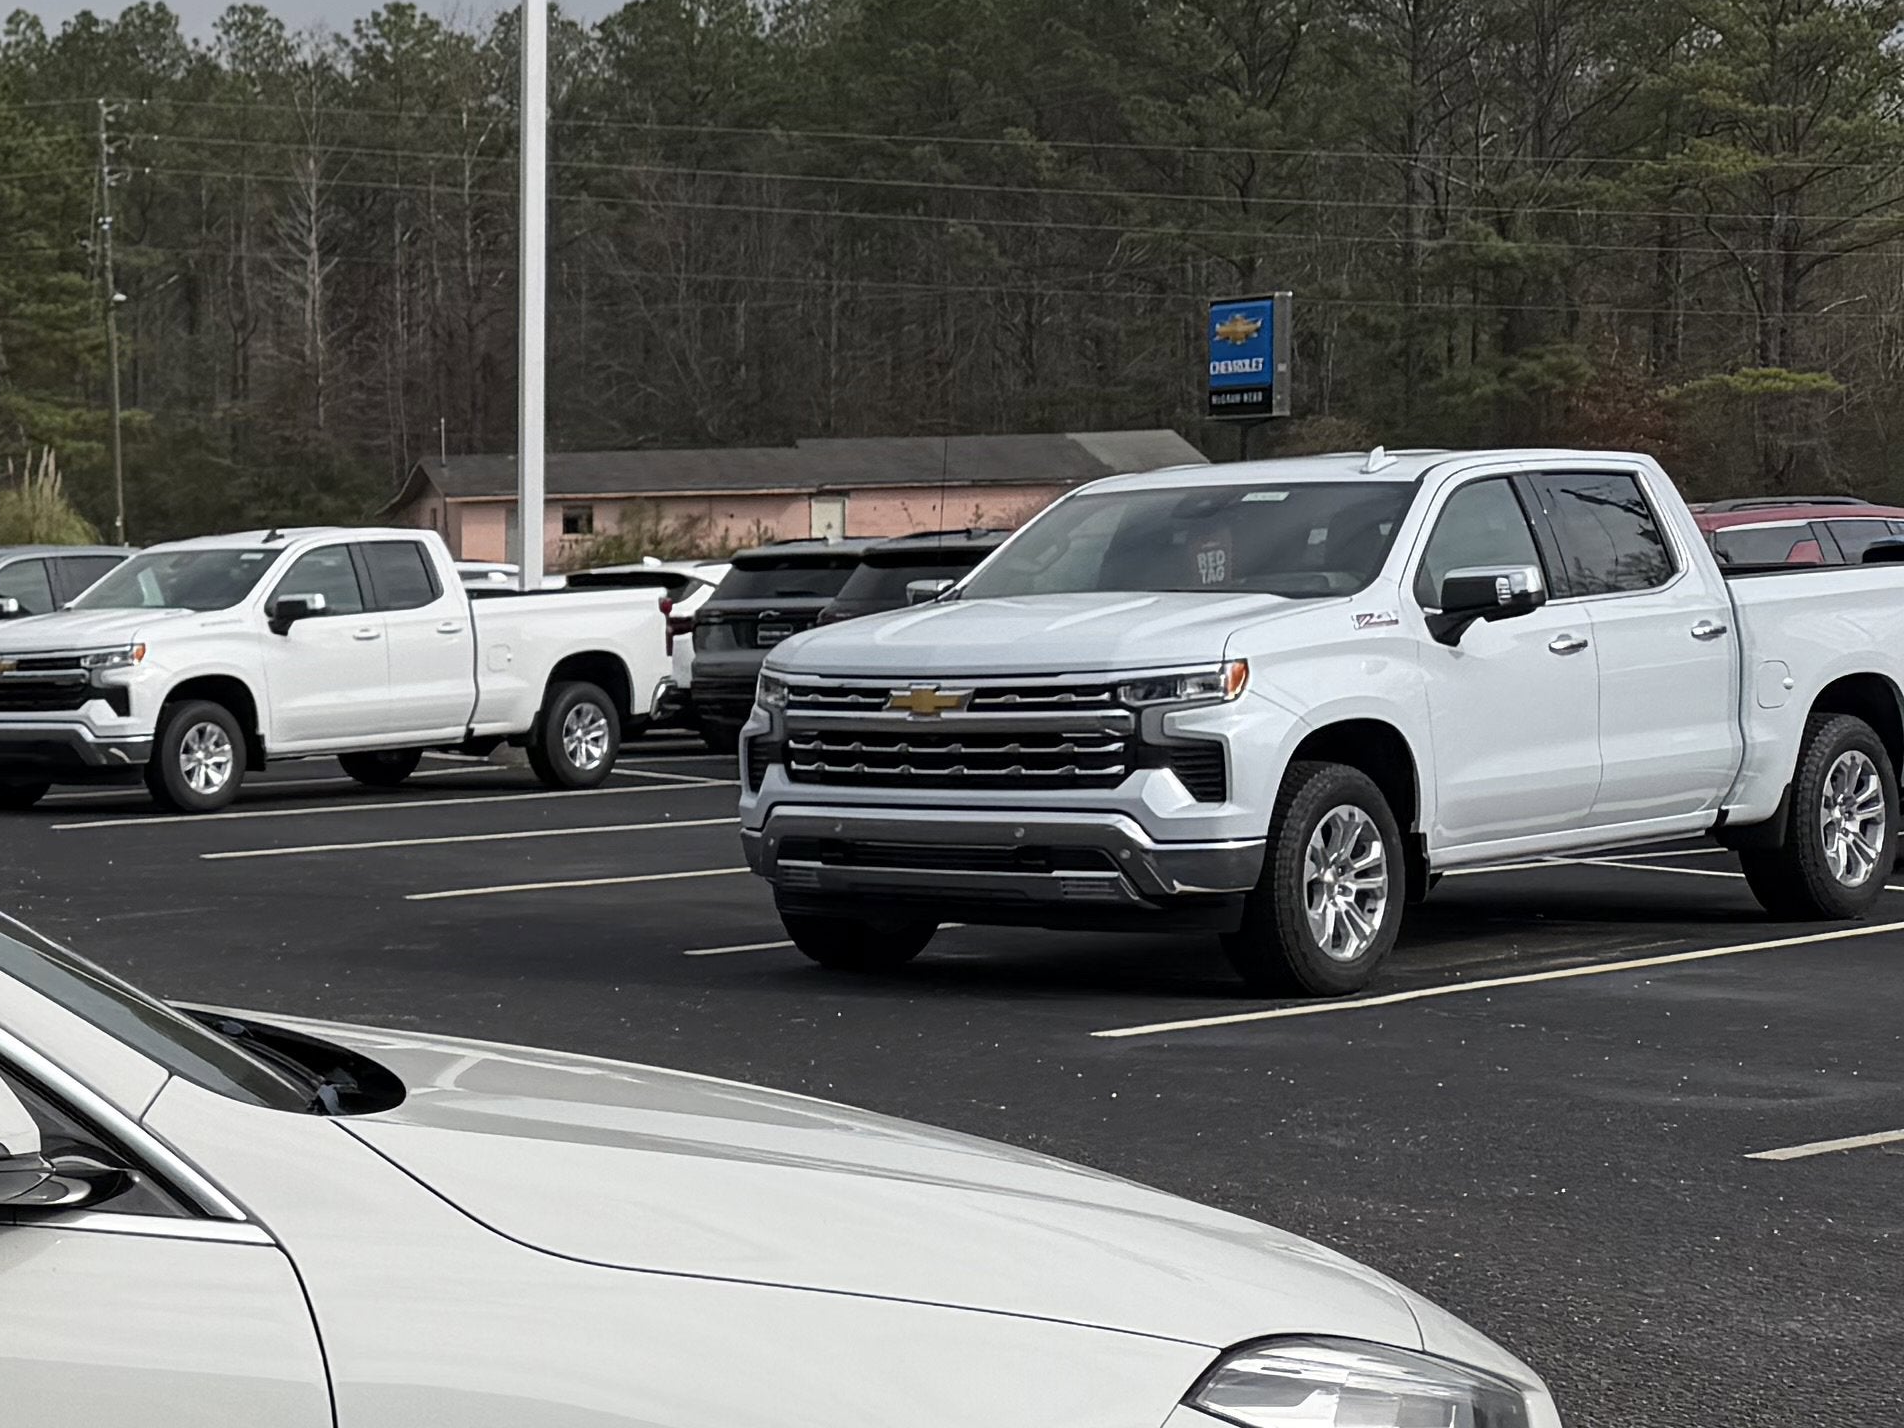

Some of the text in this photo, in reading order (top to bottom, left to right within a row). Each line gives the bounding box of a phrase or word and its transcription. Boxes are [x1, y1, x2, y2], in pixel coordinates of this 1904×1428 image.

[1209, 357, 1264, 375] CHEVROLET
[1197, 549, 1225, 570] RED
[1199, 566, 1225, 584] TAG
